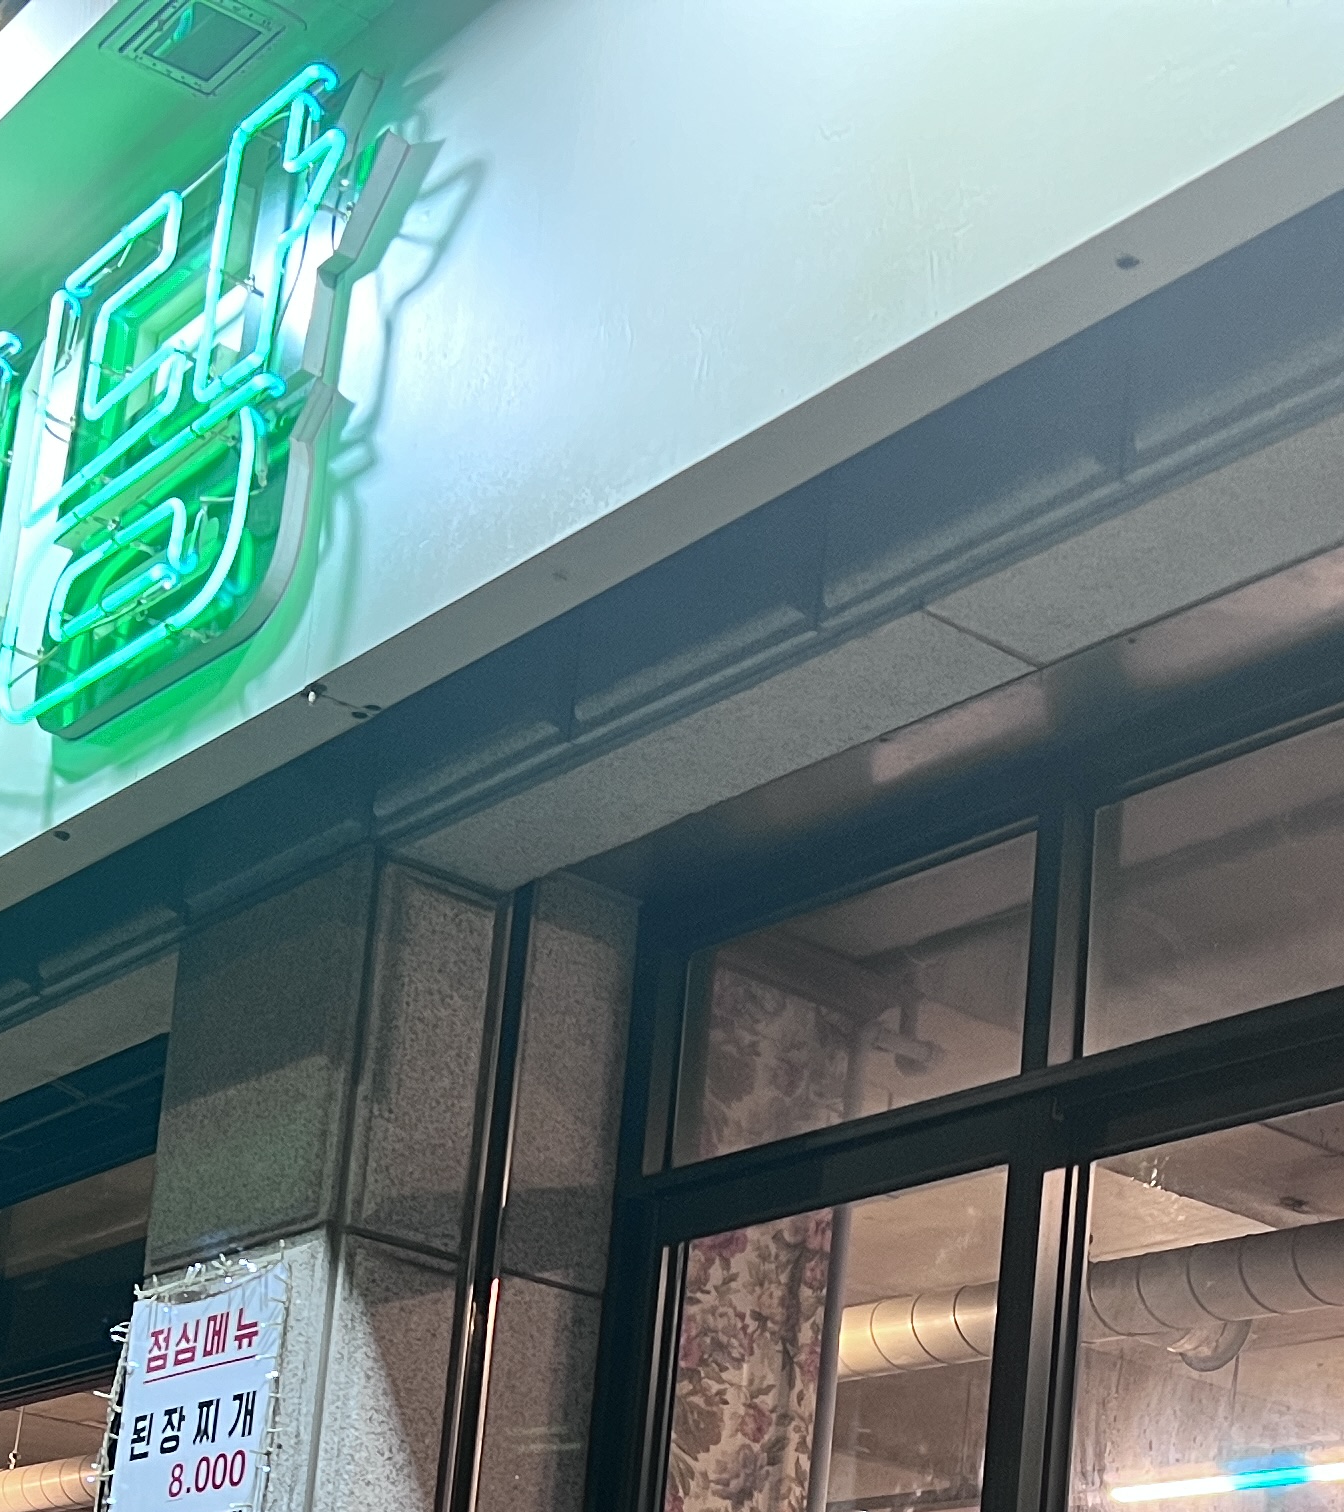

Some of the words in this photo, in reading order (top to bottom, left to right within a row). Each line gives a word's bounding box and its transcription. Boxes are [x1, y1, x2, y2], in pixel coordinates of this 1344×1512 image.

[146, 1308, 260, 1373] 점심메뉴
[130, 1390, 257, 1460] 된장찌개
[168, 1449, 247, 1498] 8.000
